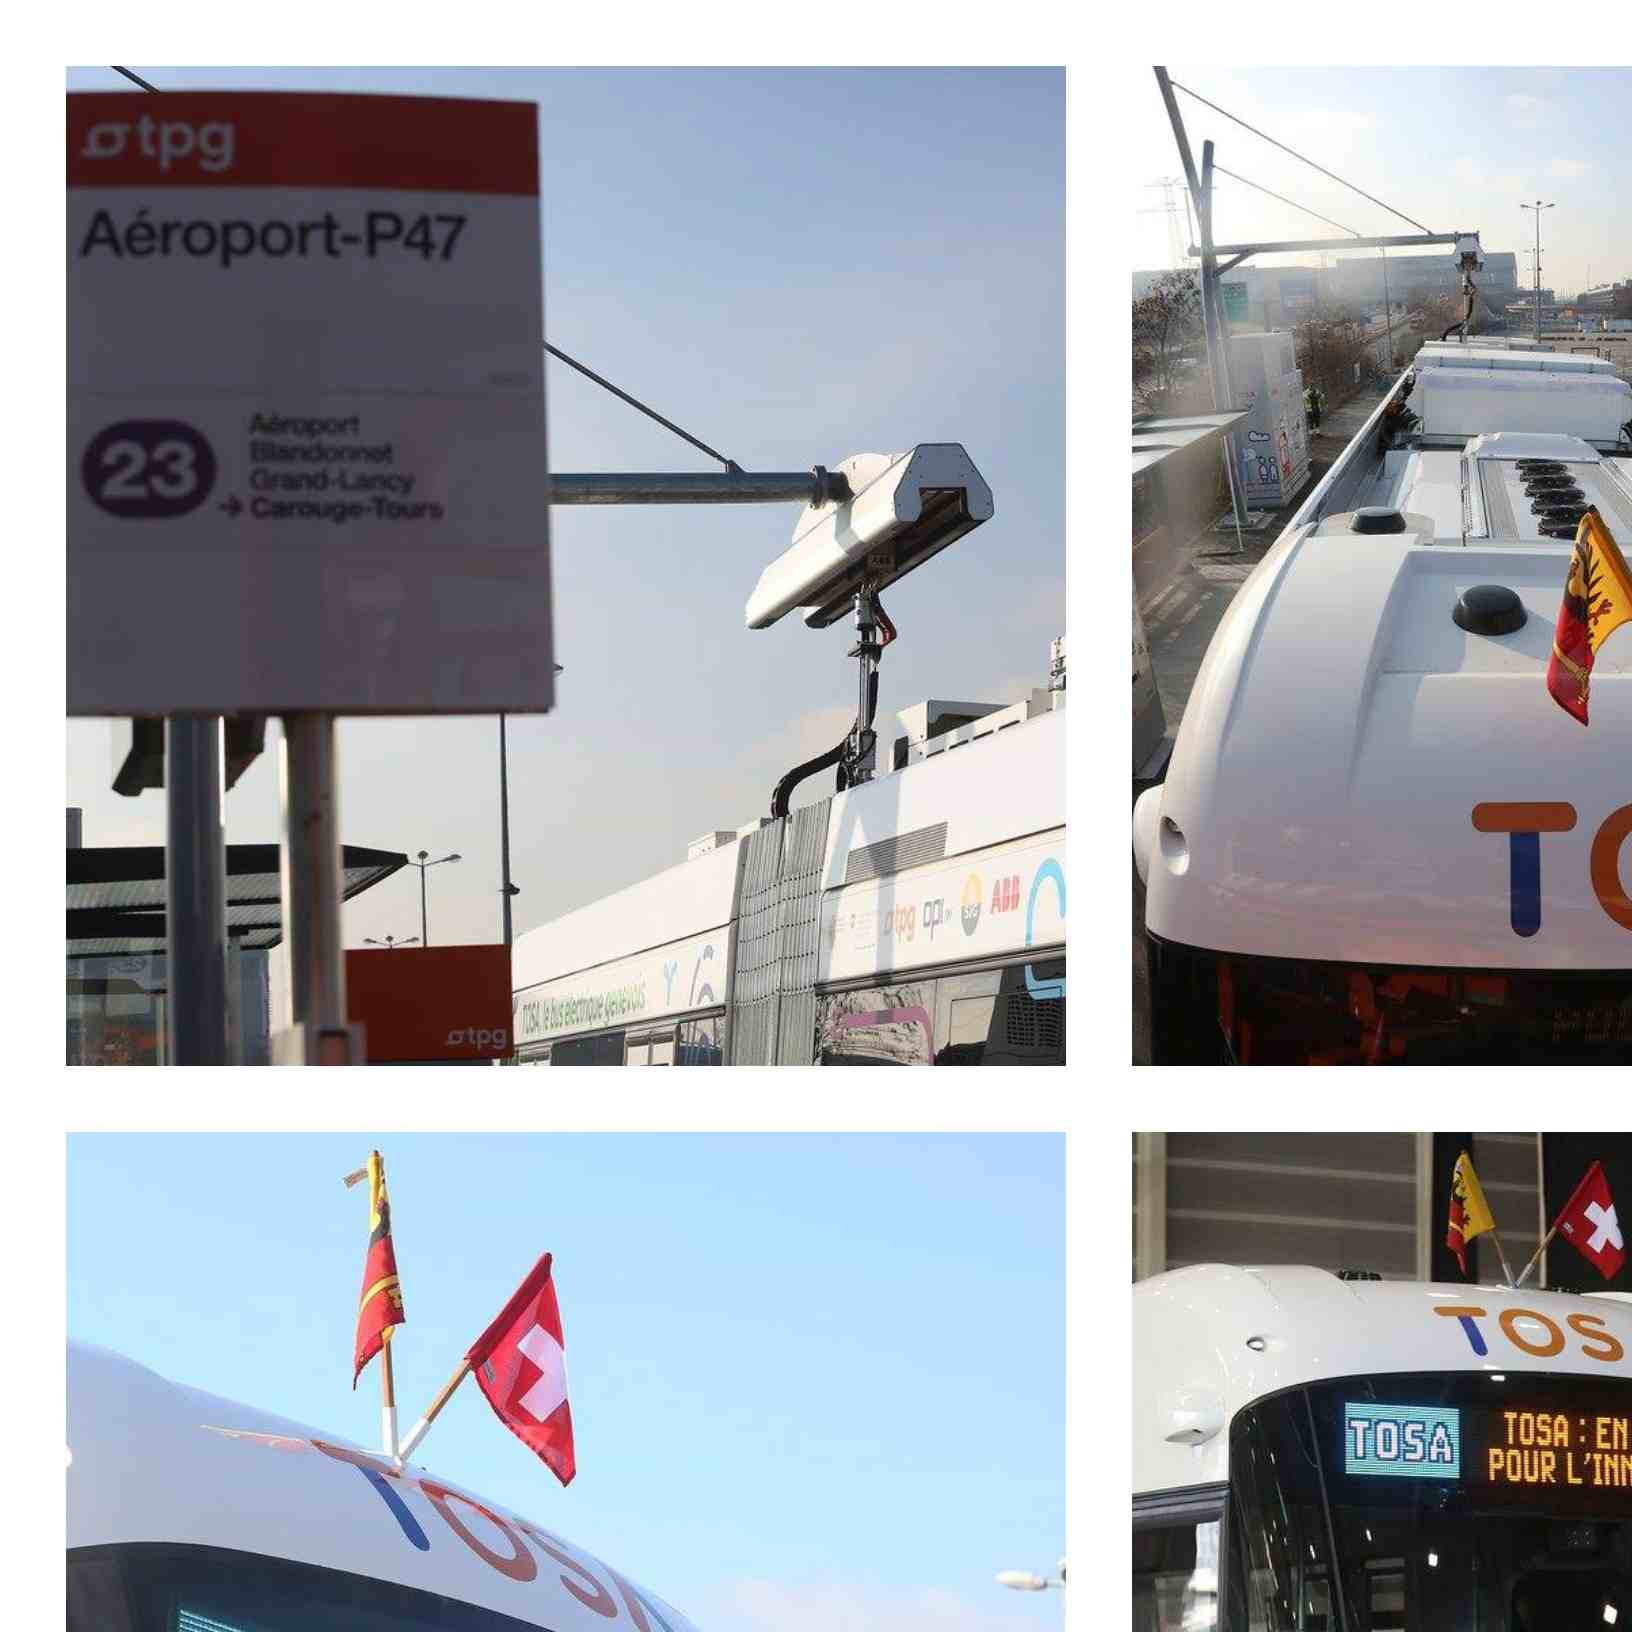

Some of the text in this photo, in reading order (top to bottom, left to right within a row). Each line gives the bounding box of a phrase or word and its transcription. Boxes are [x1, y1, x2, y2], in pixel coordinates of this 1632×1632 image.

[80, 209, 468, 269] Aéroport-P47
[249, 412, 361, 438] Aéroport
[99, 438, 200, 499] 23
[250, 467, 415, 495] Grand-Lancy
[250, 496, 444, 525] Carouge-Tours
[991, 873, 1020, 914] ABB
[469, 1027, 507, 1049] tpg
[1350, 1419, 1453, 1463] TOSA
[1503, 1411, 1568, 1448] TOSA
[1597, 1417, 1627, 1451] EN
[1488, 1448, 1556, 1483] POUR
